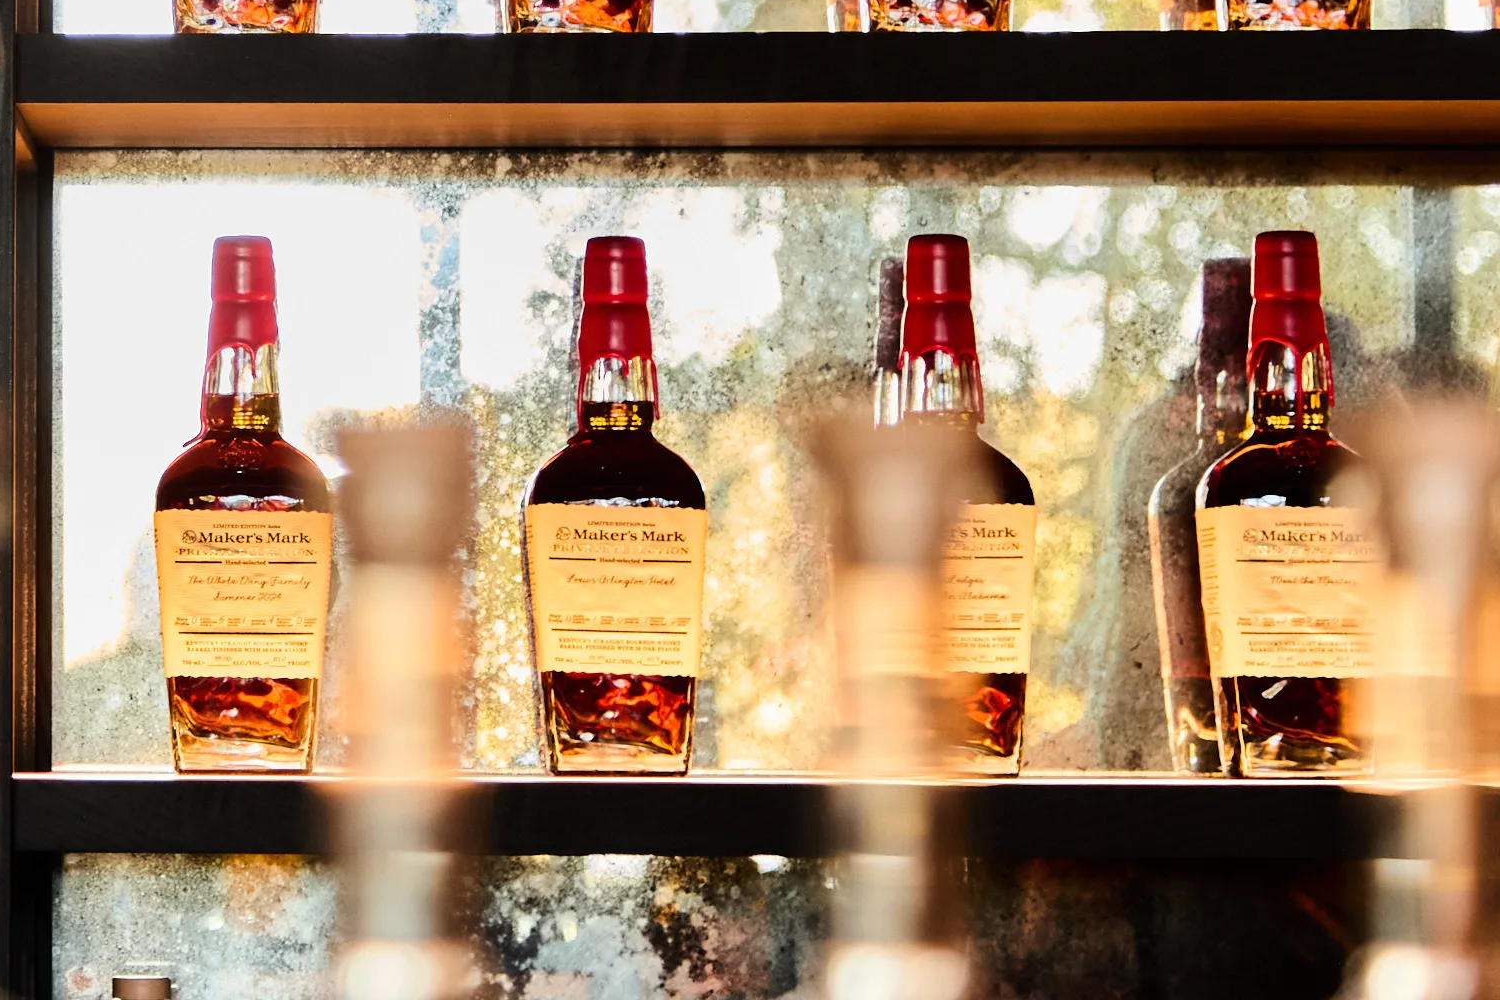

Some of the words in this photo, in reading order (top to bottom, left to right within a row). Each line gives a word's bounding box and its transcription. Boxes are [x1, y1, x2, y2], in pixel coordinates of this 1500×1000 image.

[198, 532, 263, 544] Maker's
[267, 533, 311, 543] Mark
[573, 529, 637, 541] Maker's
[642, 531, 686, 542] Mark
[972, 527, 1017, 538] Mark
[1260, 530, 1327, 542] Maker's
